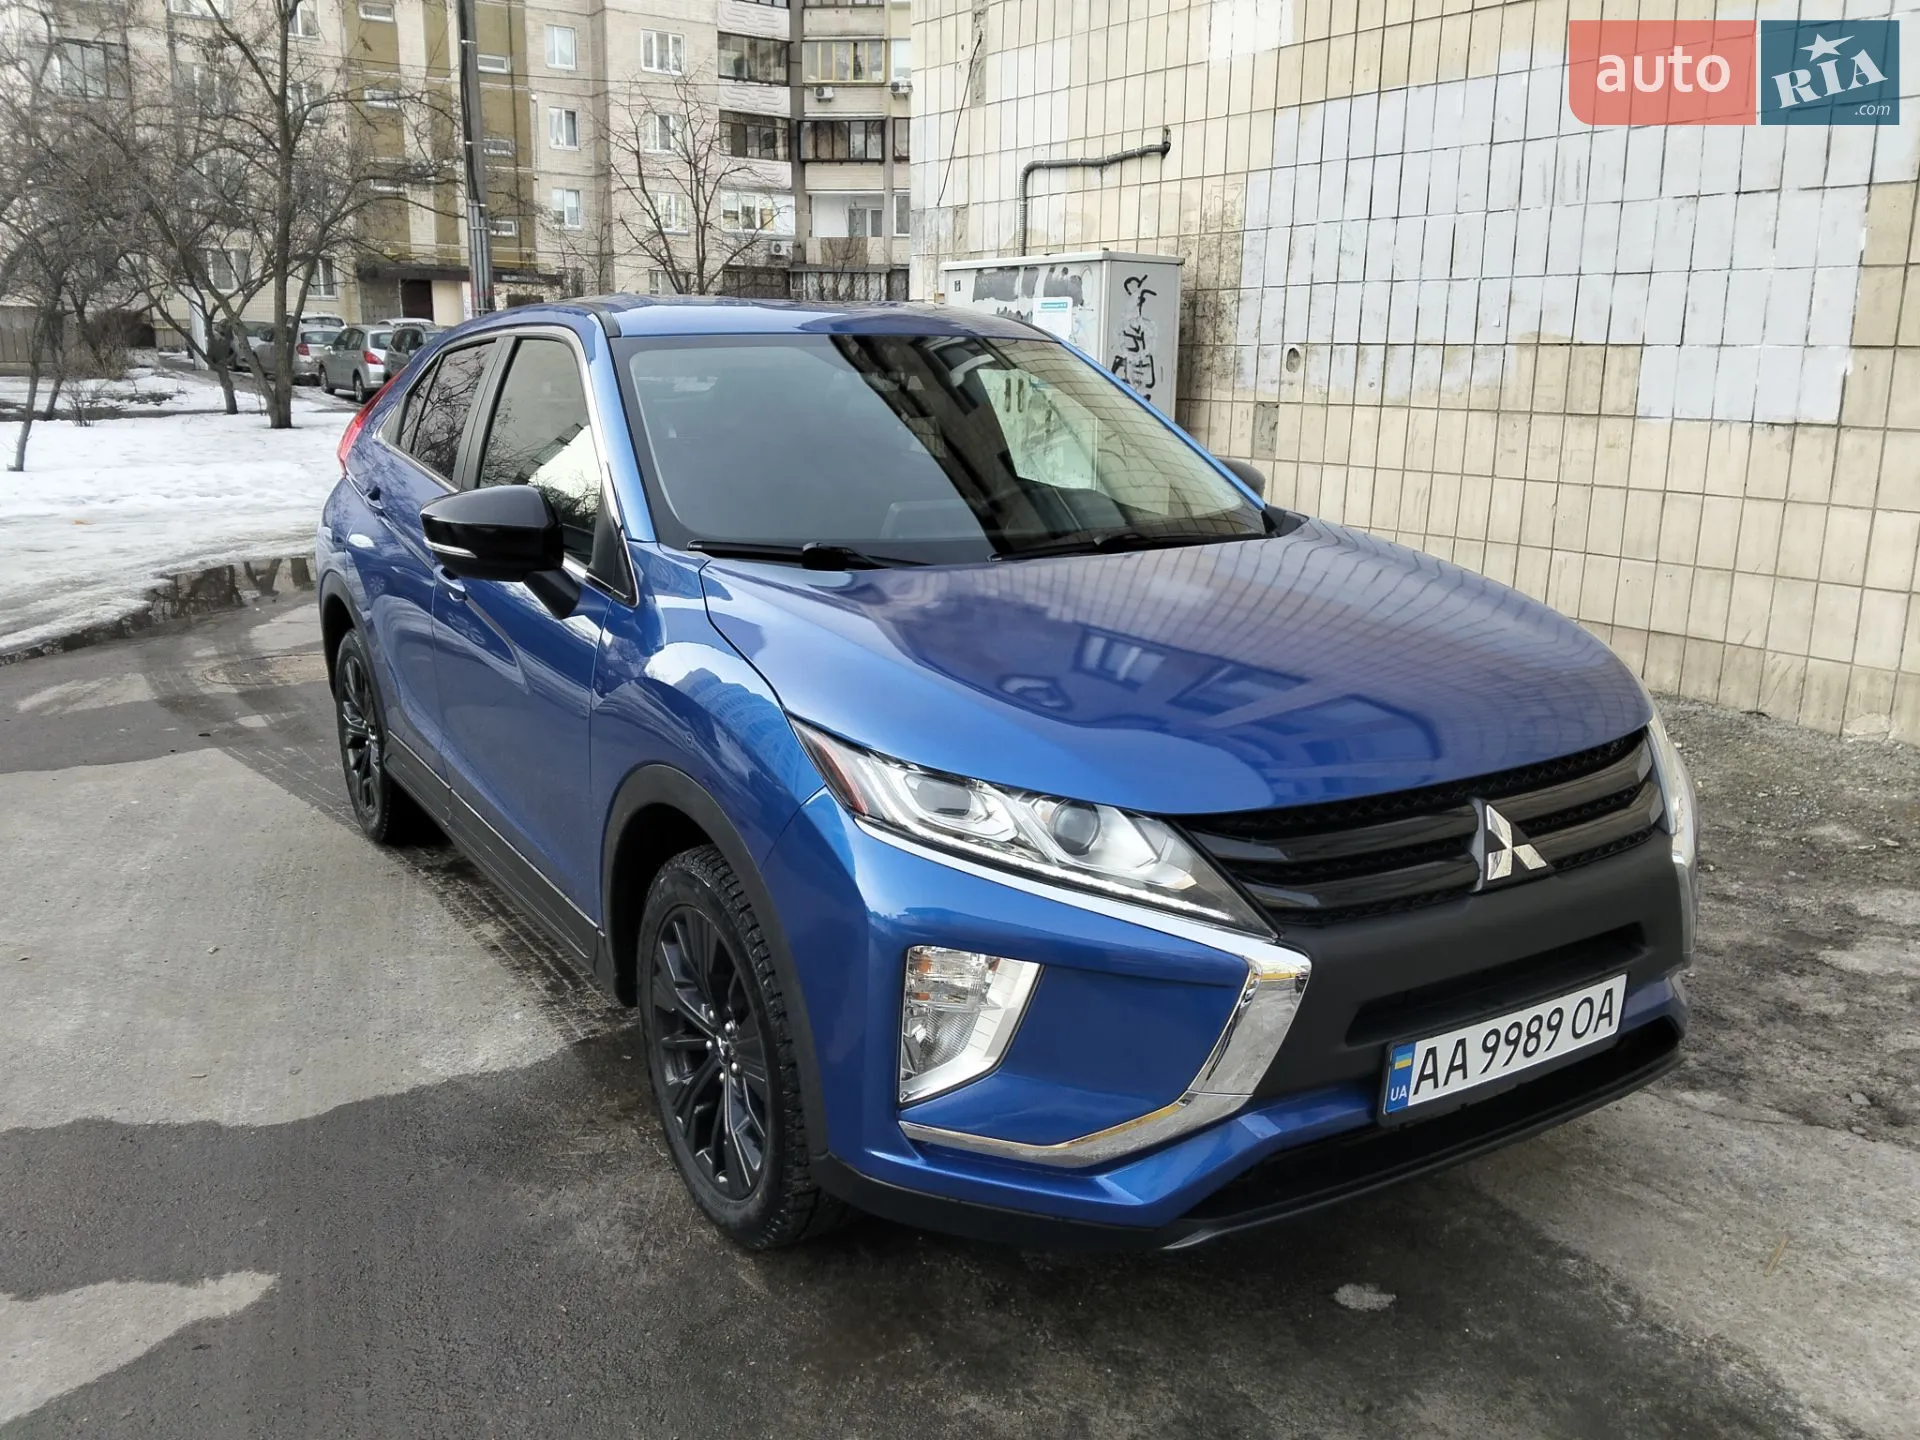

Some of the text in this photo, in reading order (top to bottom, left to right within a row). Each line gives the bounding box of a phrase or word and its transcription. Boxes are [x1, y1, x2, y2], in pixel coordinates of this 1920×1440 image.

[1413, 987, 1614, 1096] AA 9989 OA
[1390, 1085, 1408, 1101] UA
